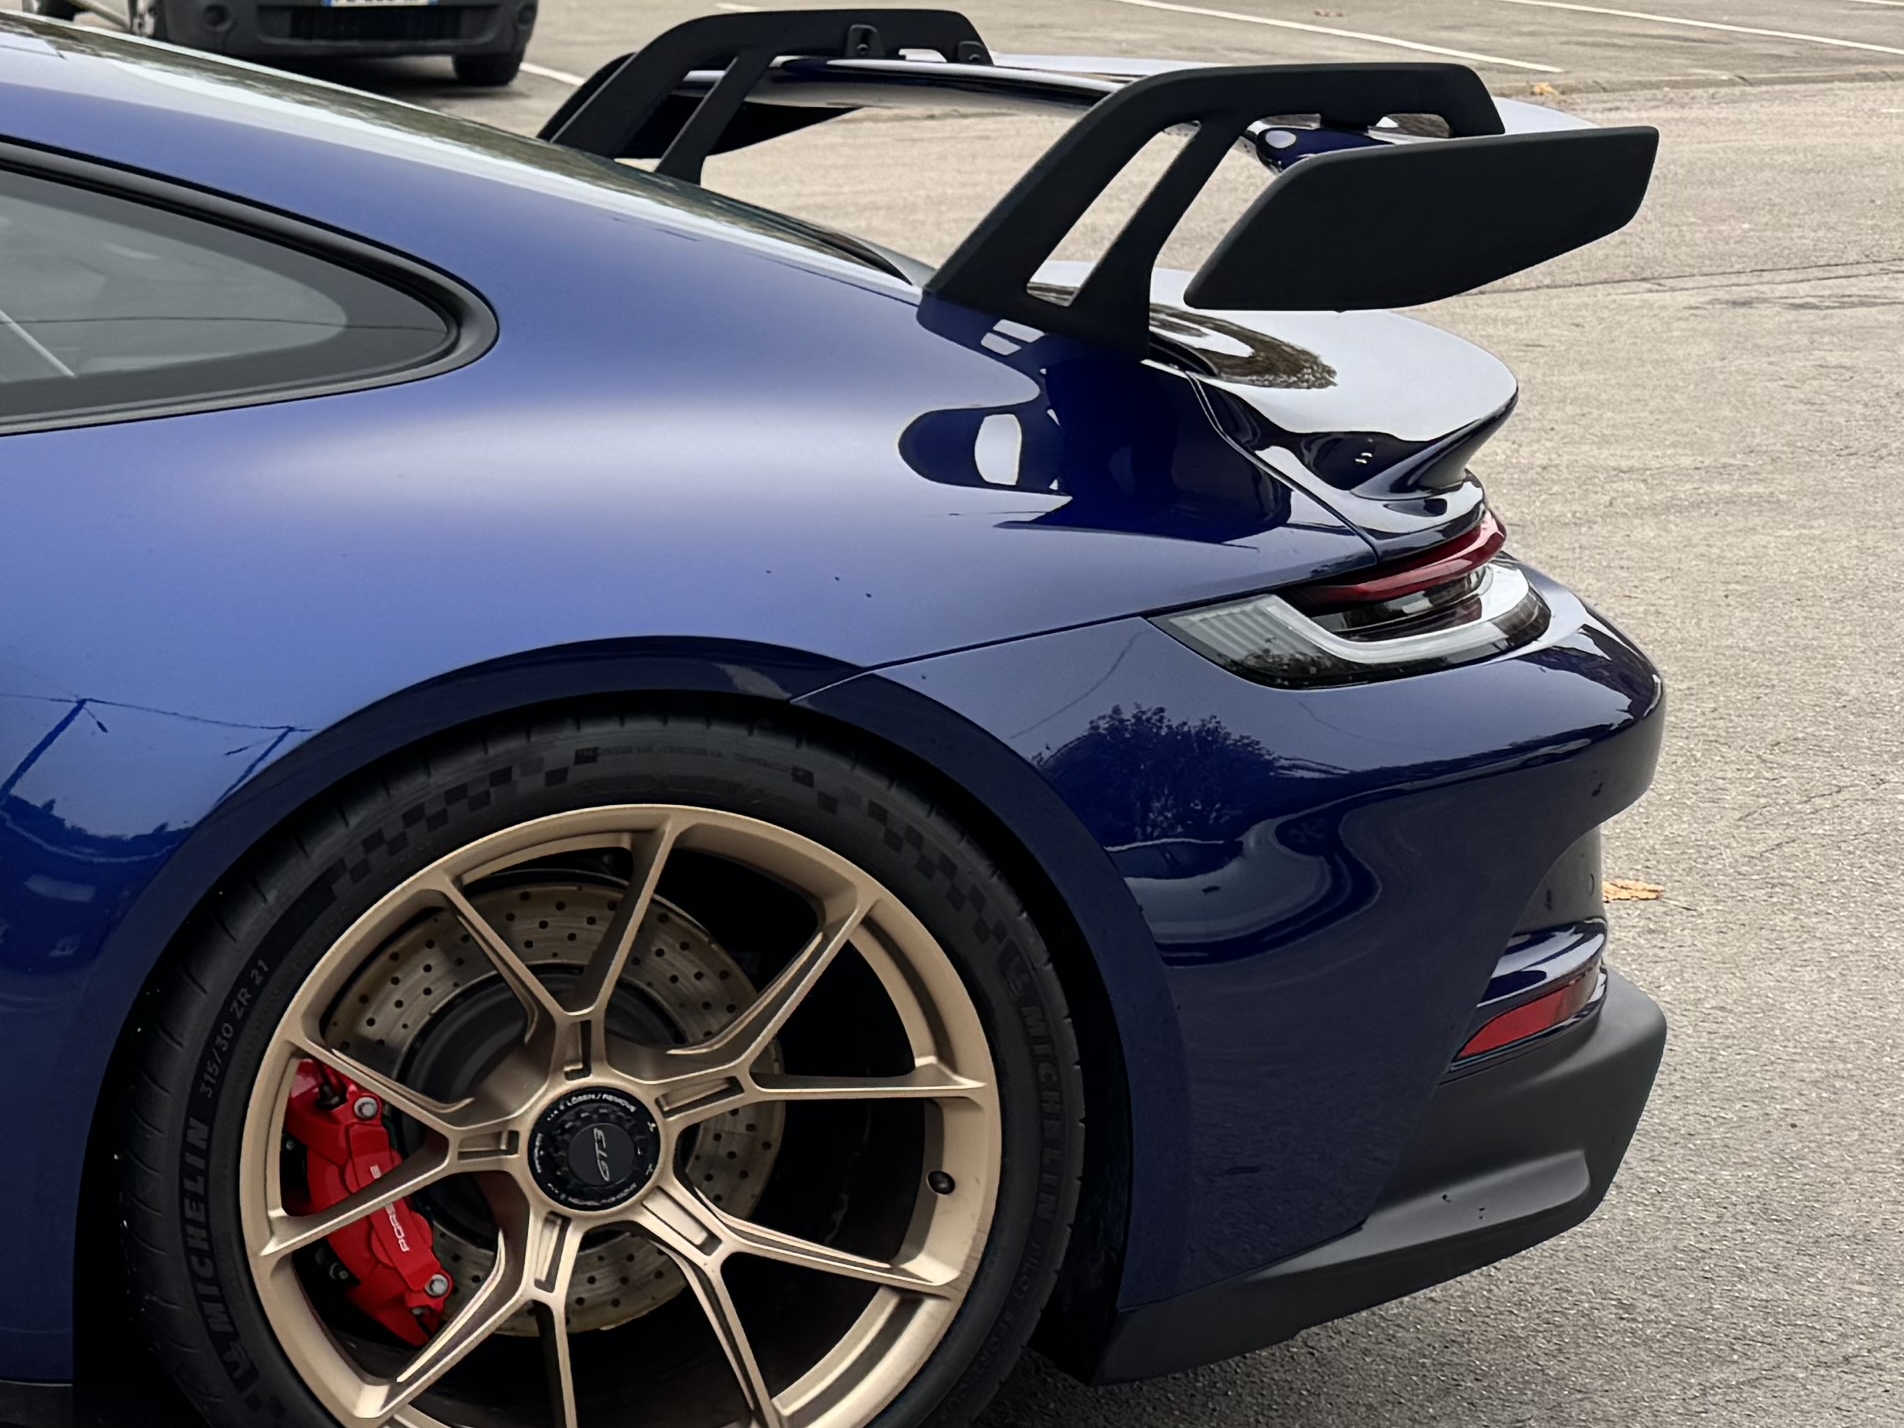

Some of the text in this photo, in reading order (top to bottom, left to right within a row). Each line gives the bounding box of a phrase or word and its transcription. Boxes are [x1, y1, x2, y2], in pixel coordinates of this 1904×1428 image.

[184, 958, 272, 1338] MICHELIN 315/30 ZR 21
[1018, 1001, 1063, 1220] MICHELIN
